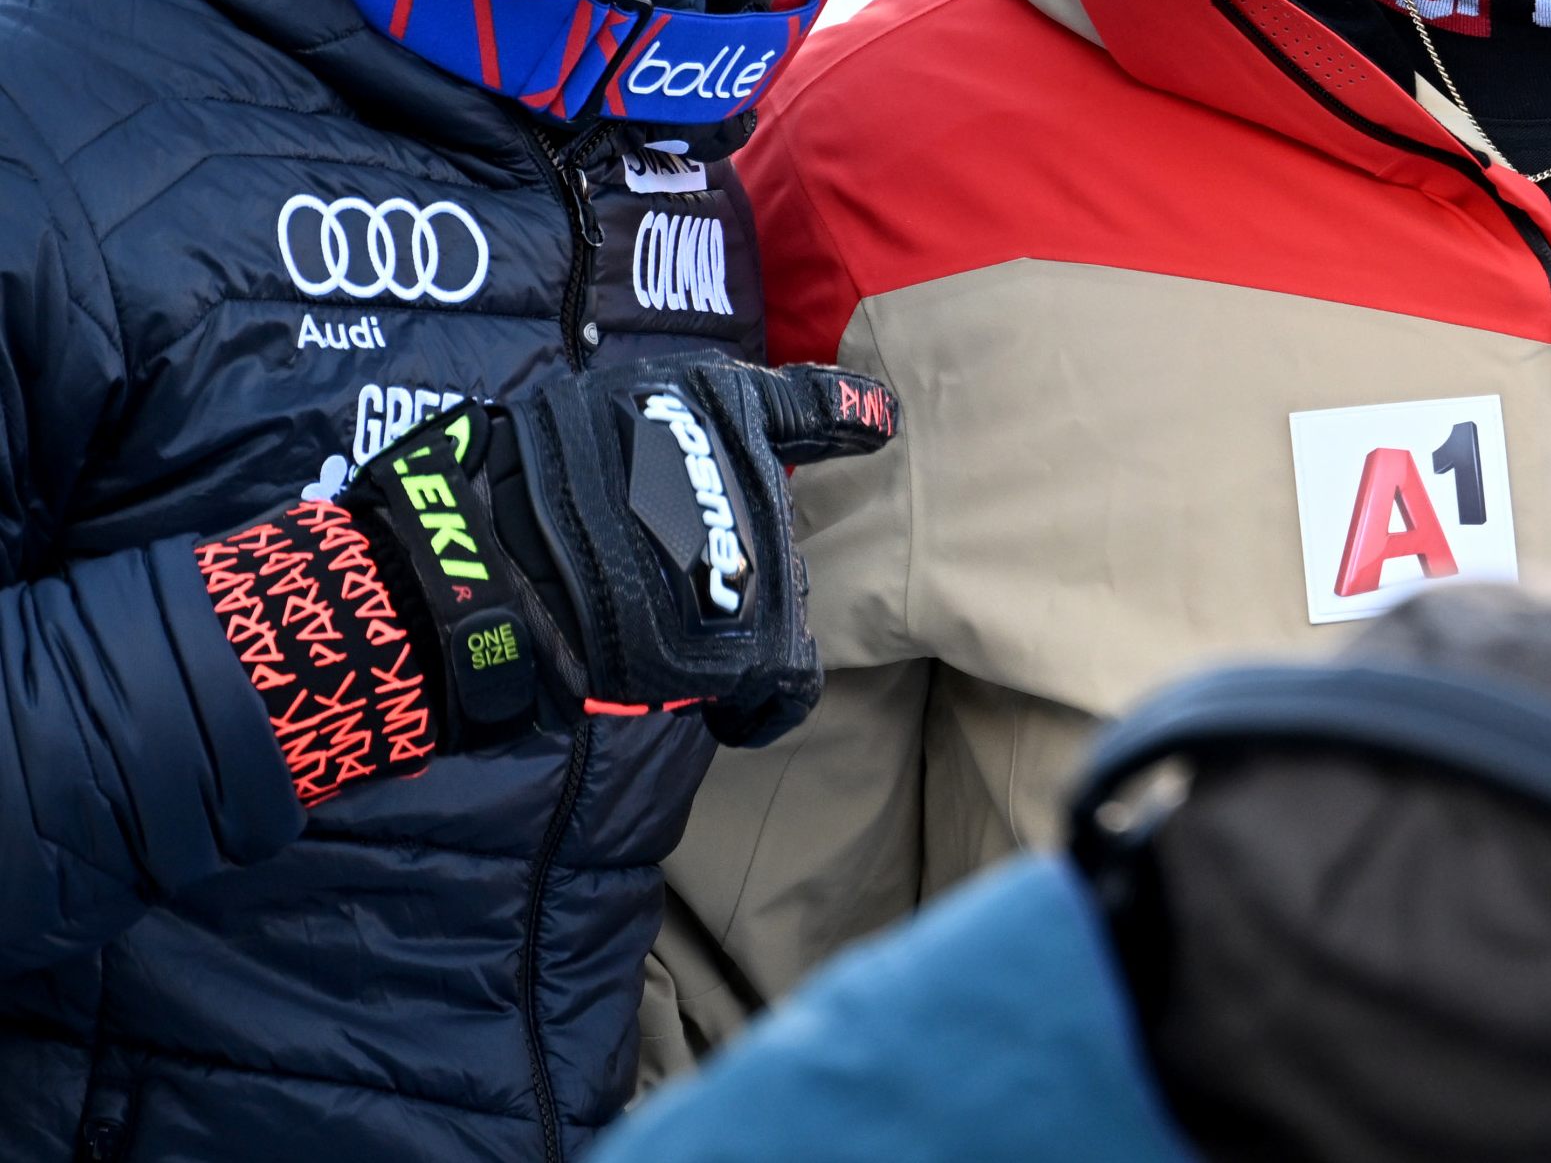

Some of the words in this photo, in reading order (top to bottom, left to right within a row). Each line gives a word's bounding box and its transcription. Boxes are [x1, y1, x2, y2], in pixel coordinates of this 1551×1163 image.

[627, 41, 777, 98] bollé
[633, 211, 734, 315] COLMAR
[297, 314, 386, 351] Audi
[644, 389, 742, 614] reusch
[1333, 420, 1487, 597] A1
[467, 624, 514, 652] ONE
[471, 641, 519, 671] SIZE
[313, 670, 377, 784] PUNK
[371, 643, 436, 762] PUNK
